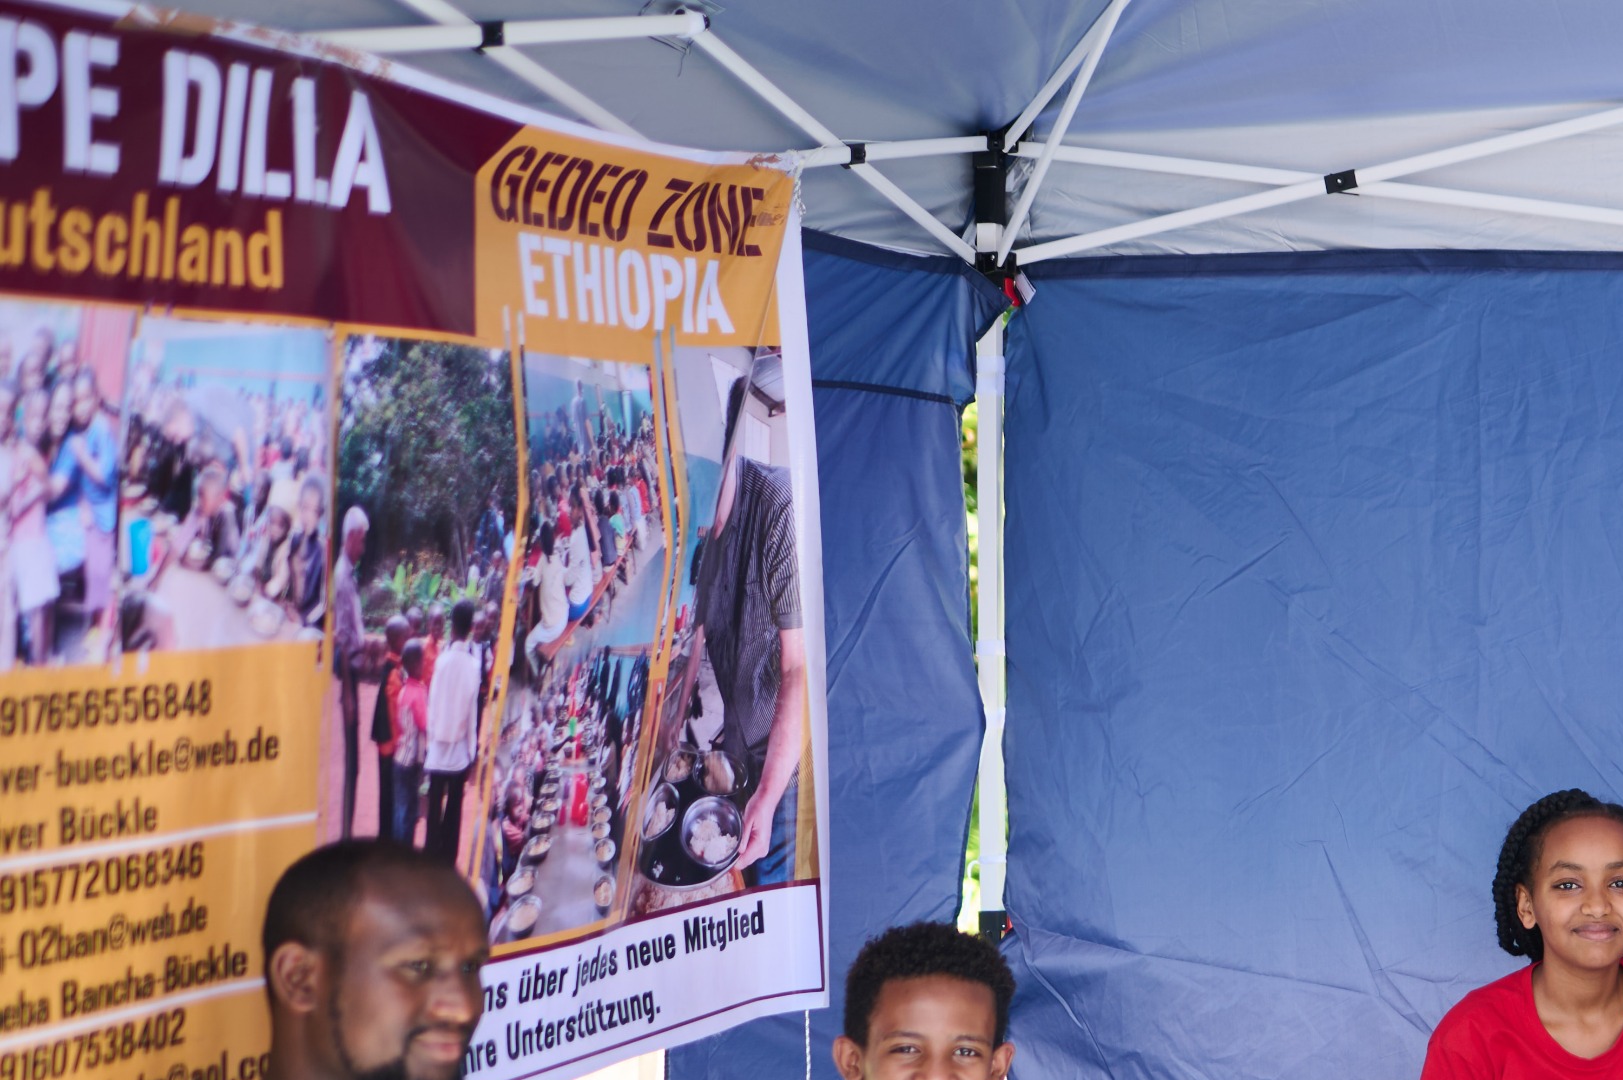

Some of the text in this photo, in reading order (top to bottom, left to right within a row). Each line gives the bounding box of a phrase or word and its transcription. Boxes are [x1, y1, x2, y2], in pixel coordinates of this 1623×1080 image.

[159, 48, 392, 214] DILLA
[0, 187, 285, 290] utschland
[491, 145, 766, 257] GEDEO ZONE
[518, 233, 736, 334] ETHIOPIA
[0, 679, 213, 736] 917656556848
[60, 797, 158, 845] Bückle
[0, 943, 248, 1031] eba Bancha-Bückle
[519, 963, 569, 1004] über
[573, 945, 618, 997] jedes
[626, 933, 676, 970] neue
[683, 900, 765, 952] Mitglied
[506, 989, 662, 1061] Unterstützung.
